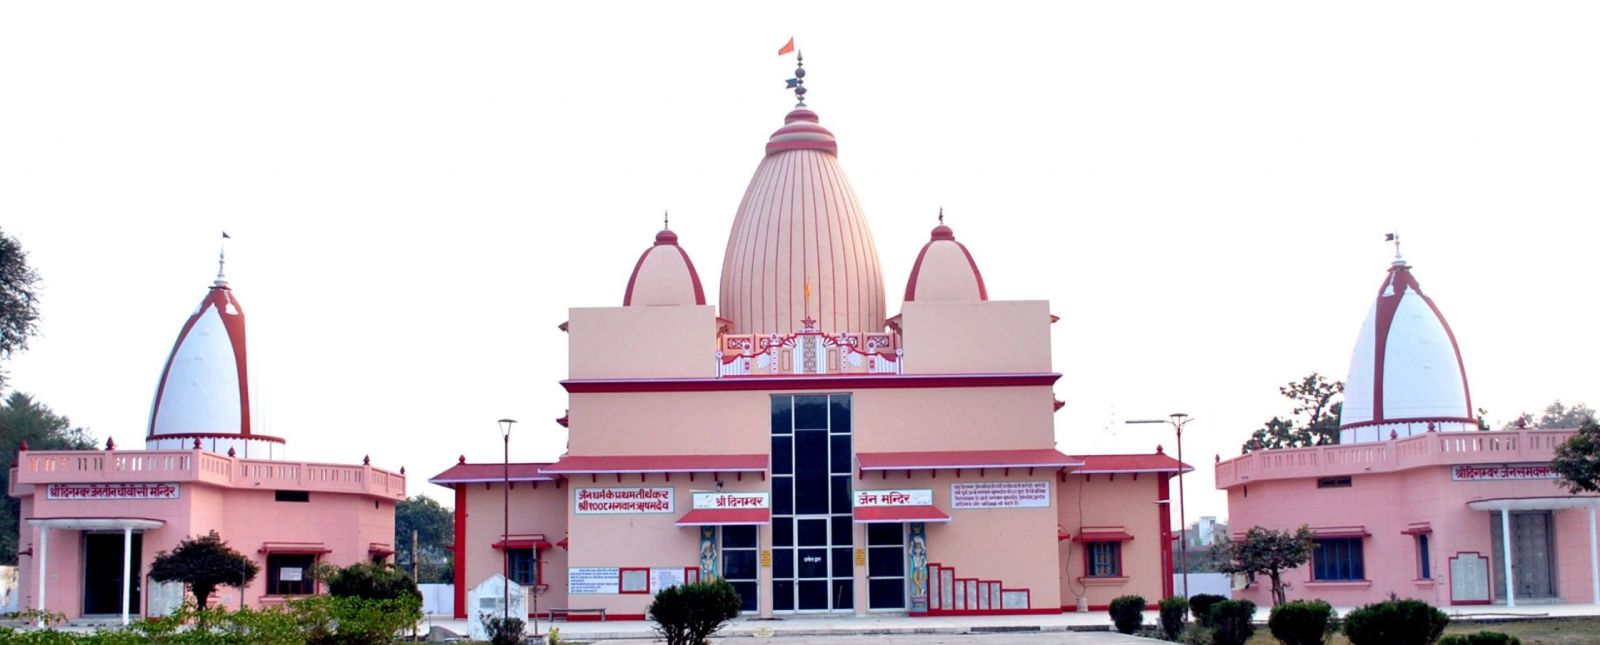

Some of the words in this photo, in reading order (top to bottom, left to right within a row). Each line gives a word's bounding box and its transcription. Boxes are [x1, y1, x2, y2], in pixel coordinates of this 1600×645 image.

[50, 485, 60, 497] श्री
[61, 484, 91, 498] दिगम्बर
[150, 483, 176, 498] मन्दिर
[579, 490, 592, 499] जैन
[716, 495, 726, 506] श्री
[727, 494, 763, 507] दिगम्बर
[859, 492, 877, 504] जैन
[881, 491, 910, 504] मन्दिर
[578, 500, 589, 511] श्री
